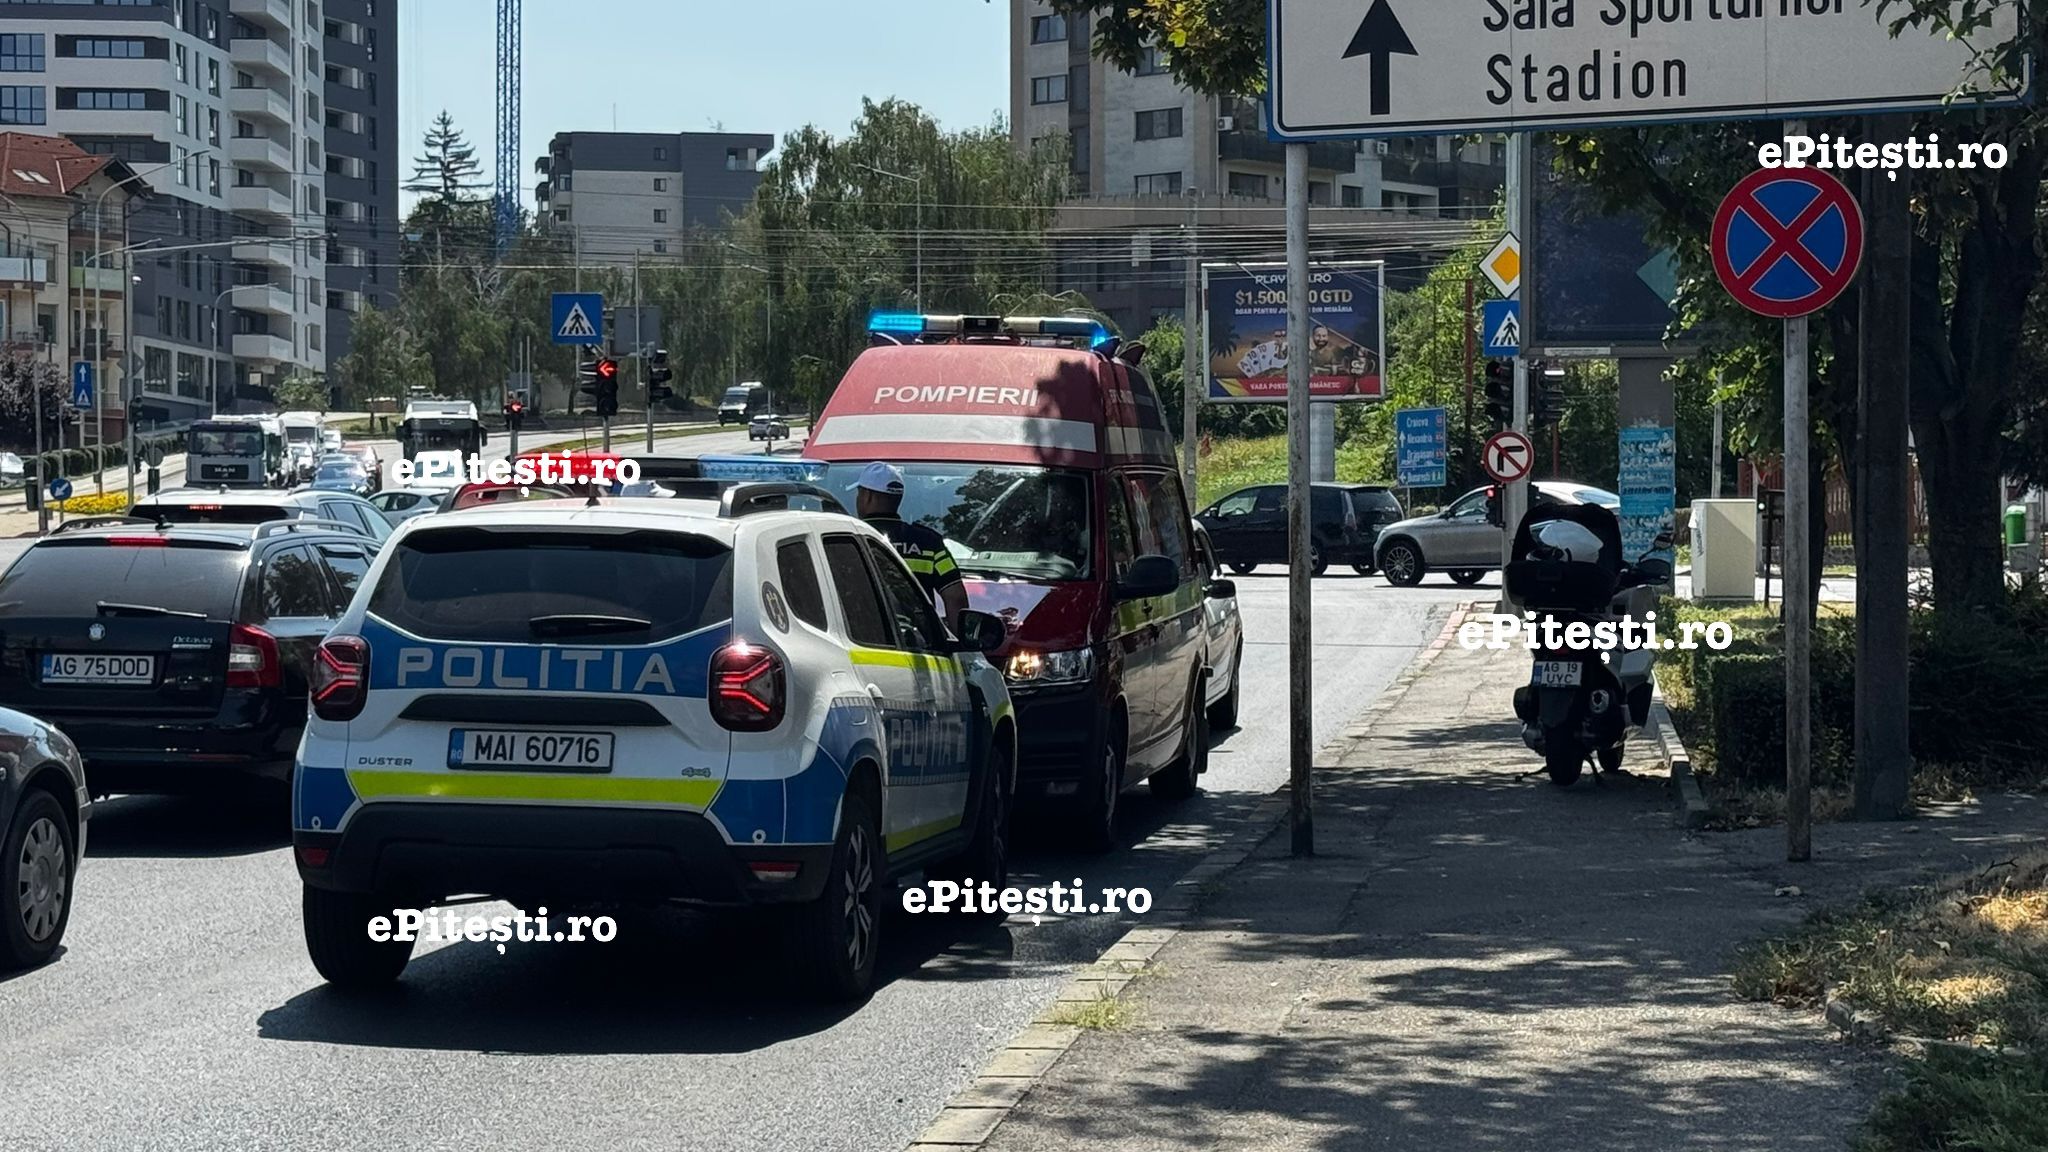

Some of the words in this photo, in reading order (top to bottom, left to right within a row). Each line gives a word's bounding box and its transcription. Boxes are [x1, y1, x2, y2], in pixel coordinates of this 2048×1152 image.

[1486, 49, 1686, 105] Stadion
[1320, 289, 1353, 304] GTD
[873, 385, 1039, 407] POMPIERII
[53, 657, 77, 675] AG
[397, 648, 675, 693] POLITIA
[1544, 662, 1560, 673] AG
[1566, 663, 1578, 673] 19
[1546, 673, 1573, 684] UYC
[474, 734, 515, 761] MAI
[525, 738, 600, 764] 60716
[358, 756, 413, 766] DUSTER
